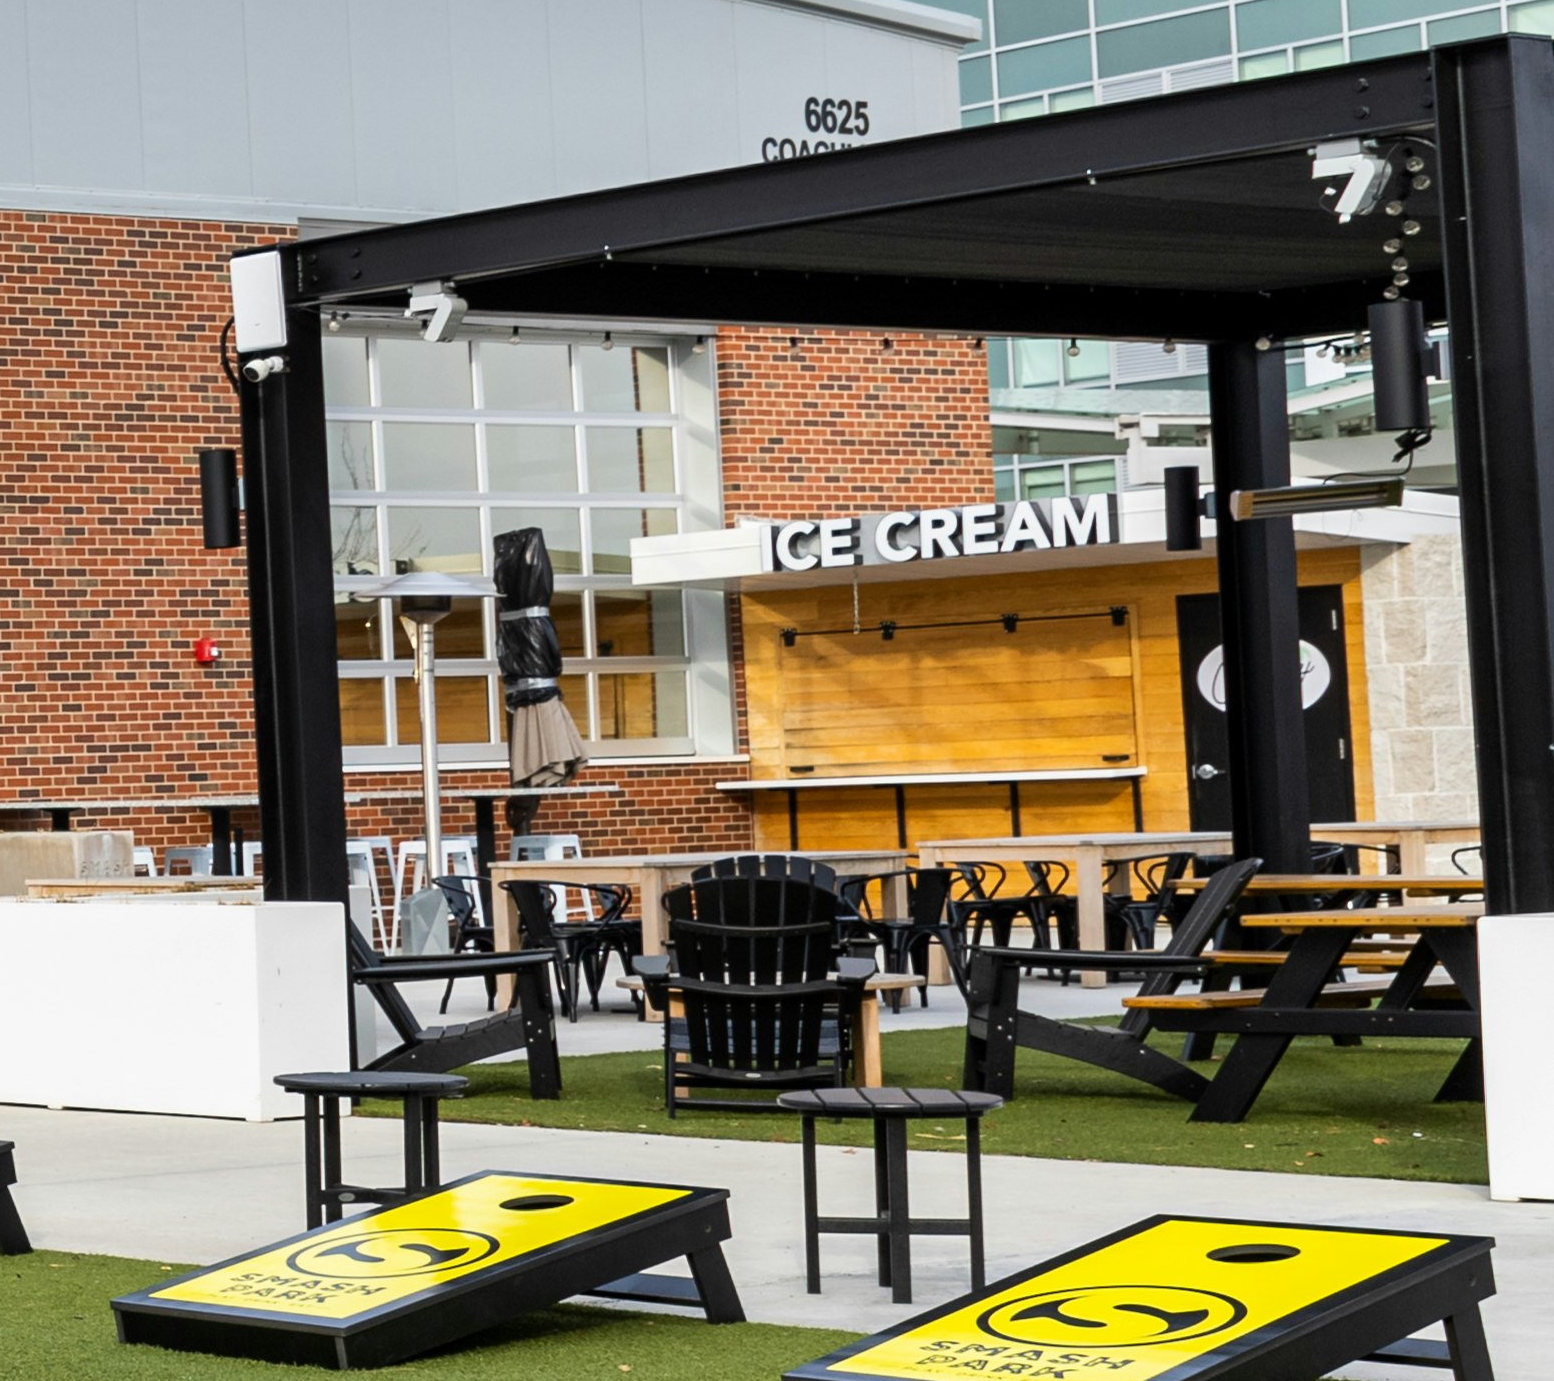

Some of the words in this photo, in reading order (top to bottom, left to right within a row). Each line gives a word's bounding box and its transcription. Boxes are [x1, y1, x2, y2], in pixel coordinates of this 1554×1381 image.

[804, 96, 869, 136] 6625
[760, 517, 857, 571] ICE
[875, 493, 1114, 563] CREAM
[219, 1284, 340, 1303] PARK
[230, 1273, 388, 1296] SMASH
[915, 1355, 1079, 1379] PARK
[920, 1340, 1138, 1369] SMASH
